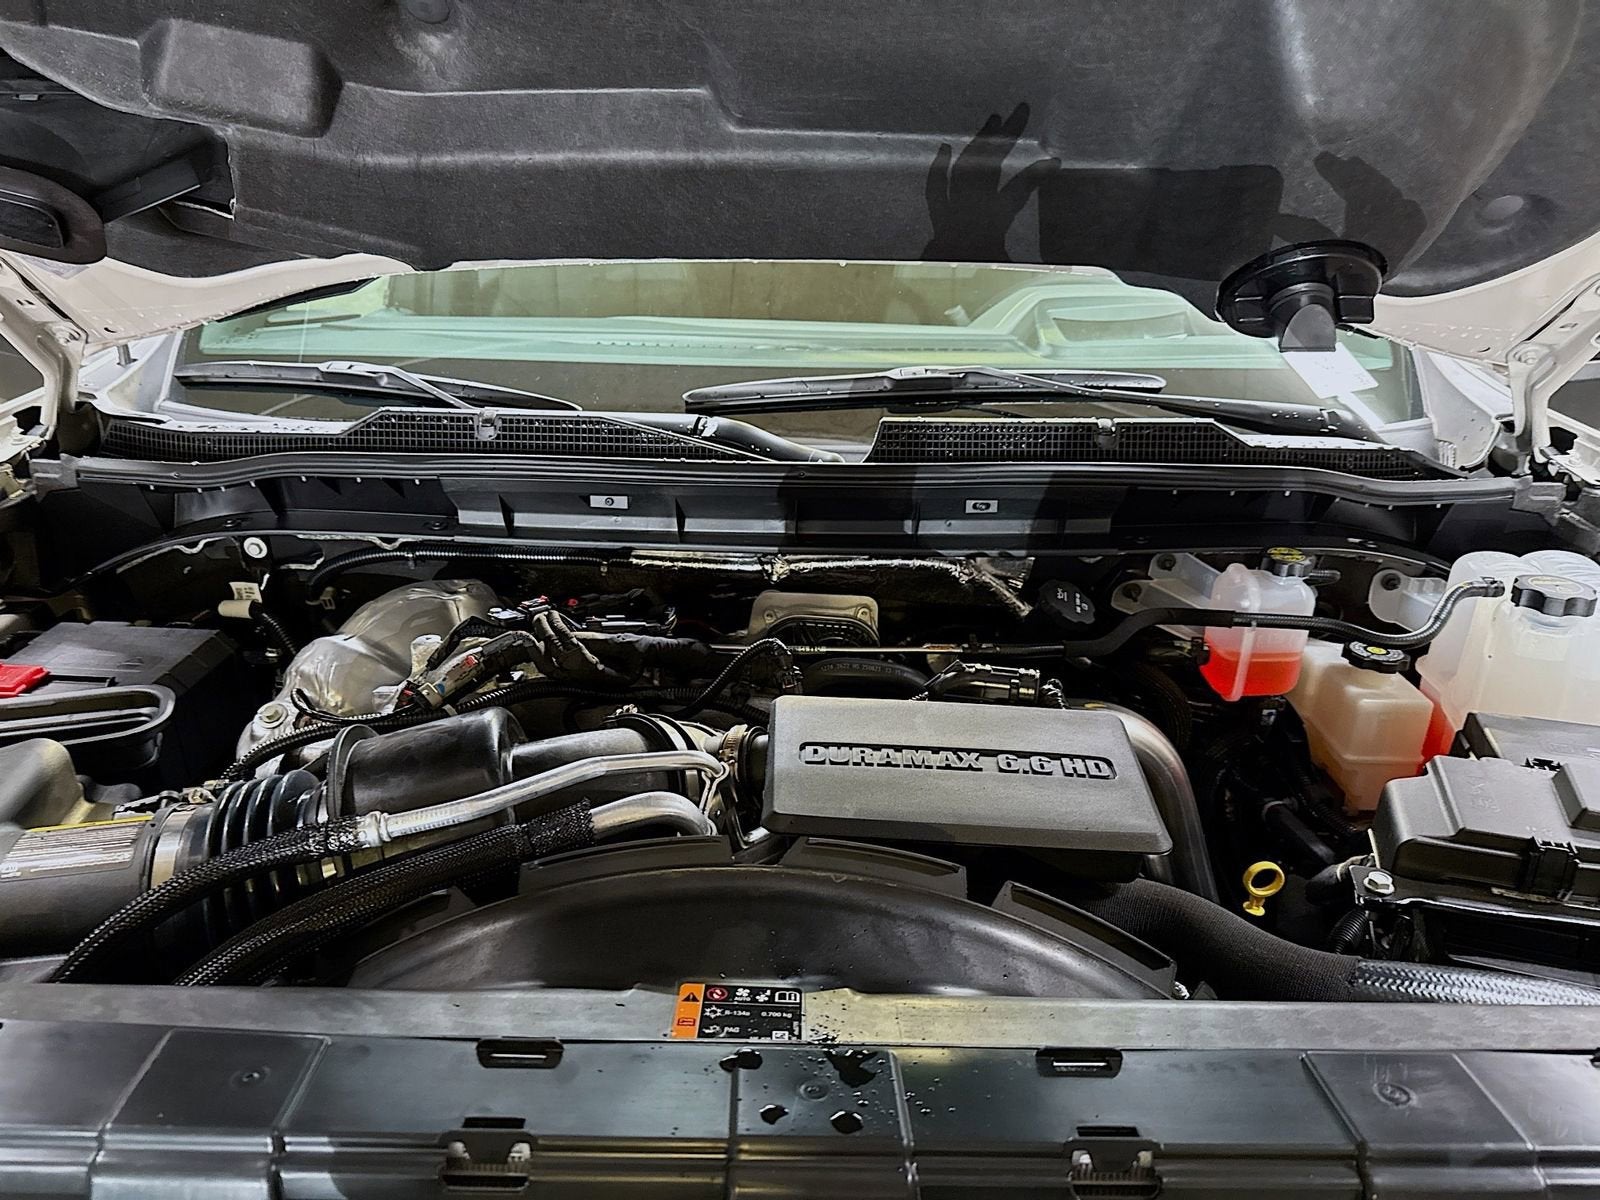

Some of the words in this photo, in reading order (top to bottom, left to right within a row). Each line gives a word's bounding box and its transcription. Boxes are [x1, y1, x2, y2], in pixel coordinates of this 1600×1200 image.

[804, 745, 983, 771] DURAMAX
[997, 754, 1054, 775] 6.6
[1060, 757, 1114, 779] HD
